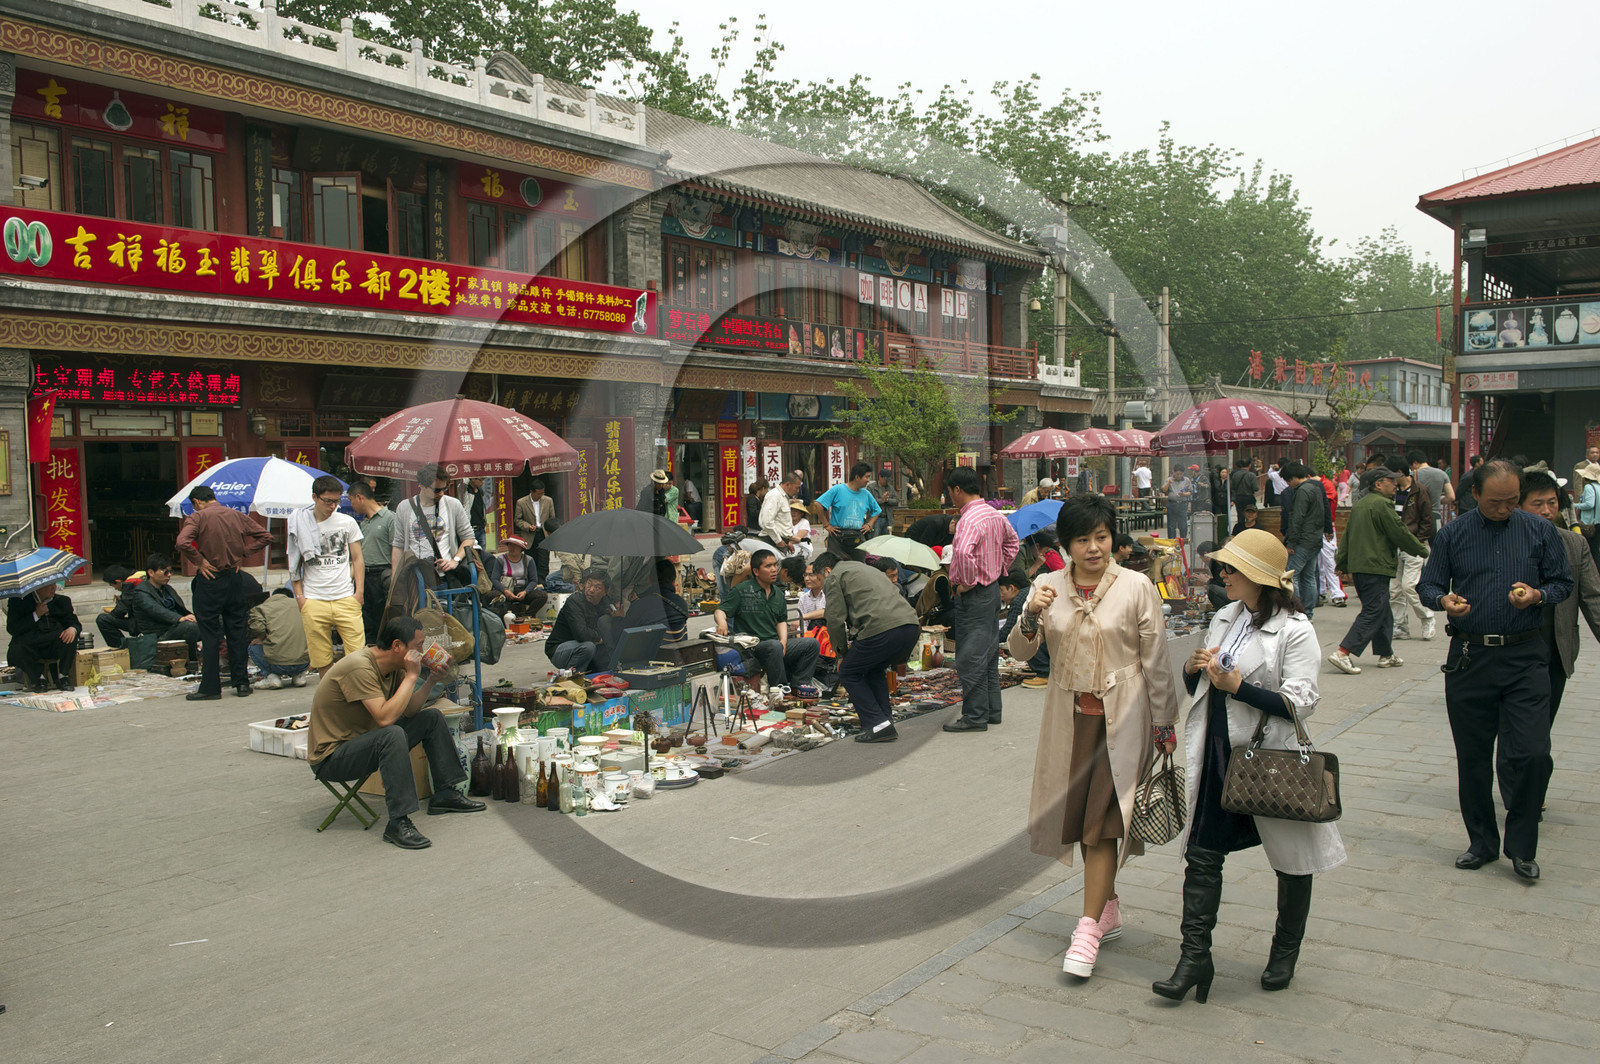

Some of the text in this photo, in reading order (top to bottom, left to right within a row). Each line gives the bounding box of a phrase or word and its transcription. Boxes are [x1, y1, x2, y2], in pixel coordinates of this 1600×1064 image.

[37, 78, 190, 141] 吉 祥
[480, 168, 580, 212] 福 玉
[65, 225, 451, 307] 吉祥福玉翡翠俱乐部2楼
[455, 275, 503, 294] 厂家直销
[596, 293, 633, 309] 来料加工
[455, 291, 502, 310] 批发零售
[507, 298, 552, 316] 珍品交流
[860, 276, 893, 305] 咖啡
[35, 364, 240, 393] 七宝珊瑚 专营天然珊瑚
[456, 417, 474, 452] 吉祥福玉
[602, 420, 624, 511] 翡翠俱乐部
[767, 450, 780, 489] 天然
[831, 449, 843, 487] 兆勇
[210, 481, 252, 491] Haier
[723, 447, 739, 526] 青田石
[324, 558, 334, 566] Mr
